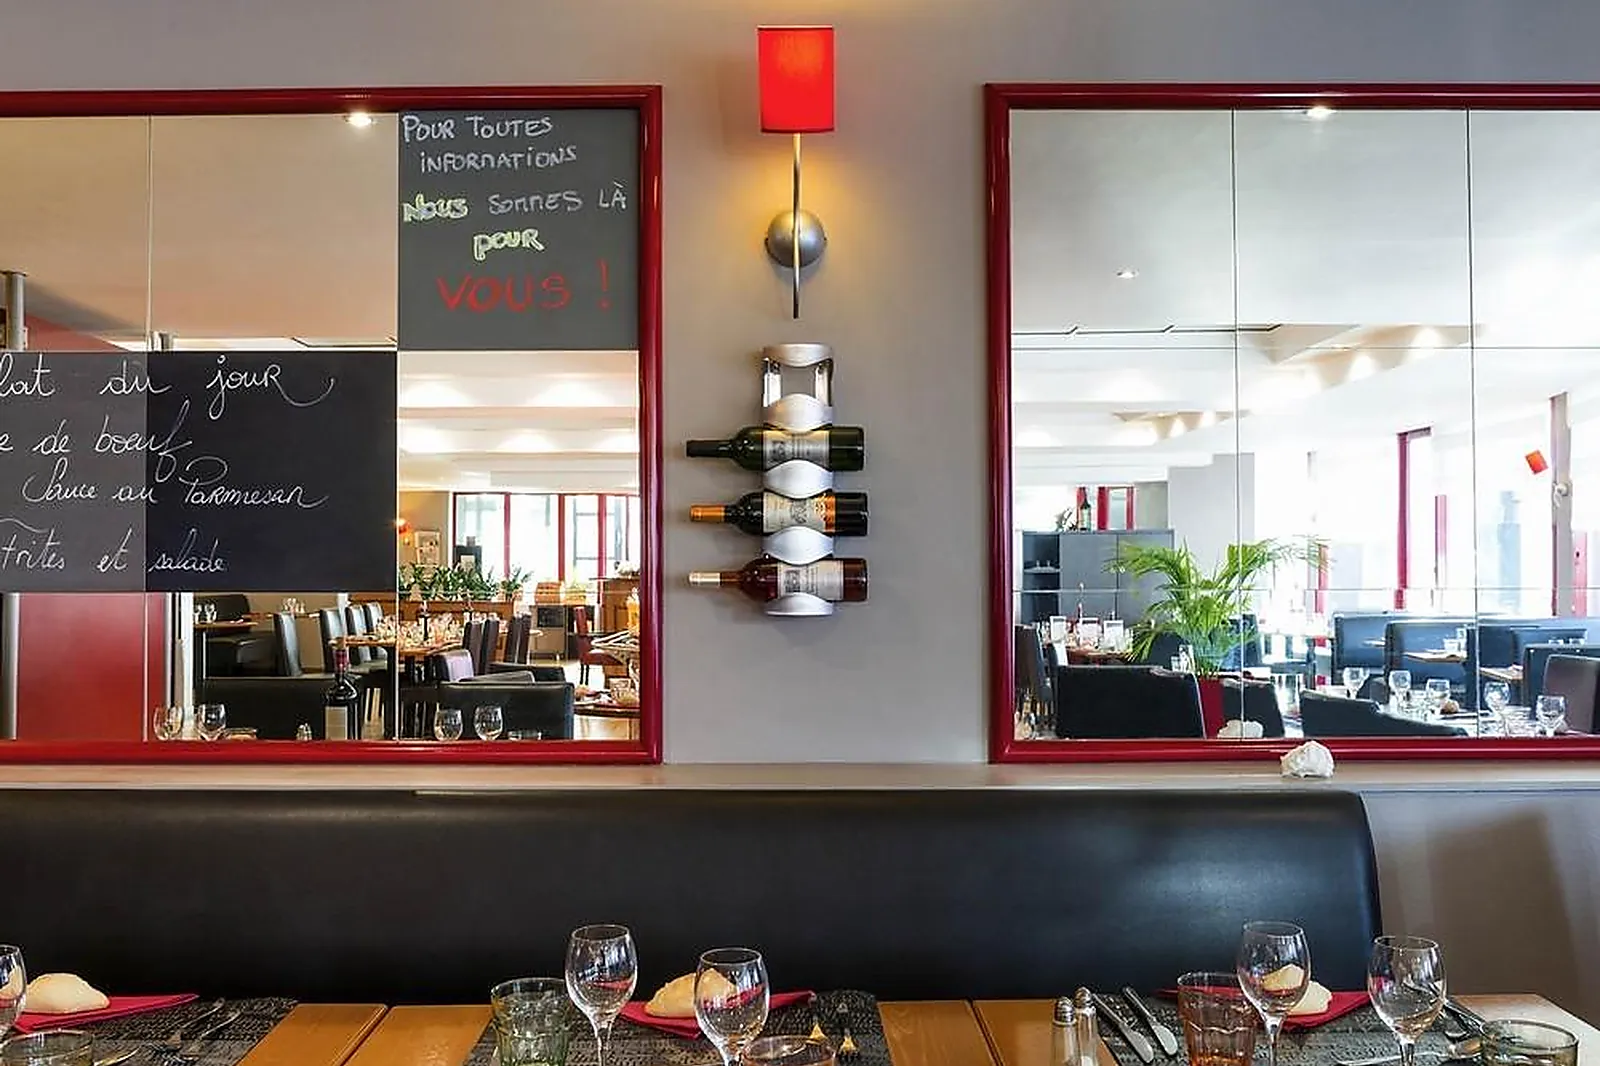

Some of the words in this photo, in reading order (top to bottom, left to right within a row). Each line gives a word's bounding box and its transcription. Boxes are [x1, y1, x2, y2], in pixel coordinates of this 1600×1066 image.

[436, 273, 572, 312] VOUS
[99, 359, 172, 394] du
[33, 419, 70, 456] de
[112, 485, 158, 504] au
[96, 527, 133, 572] et
[148, 528, 226, 573] salade
